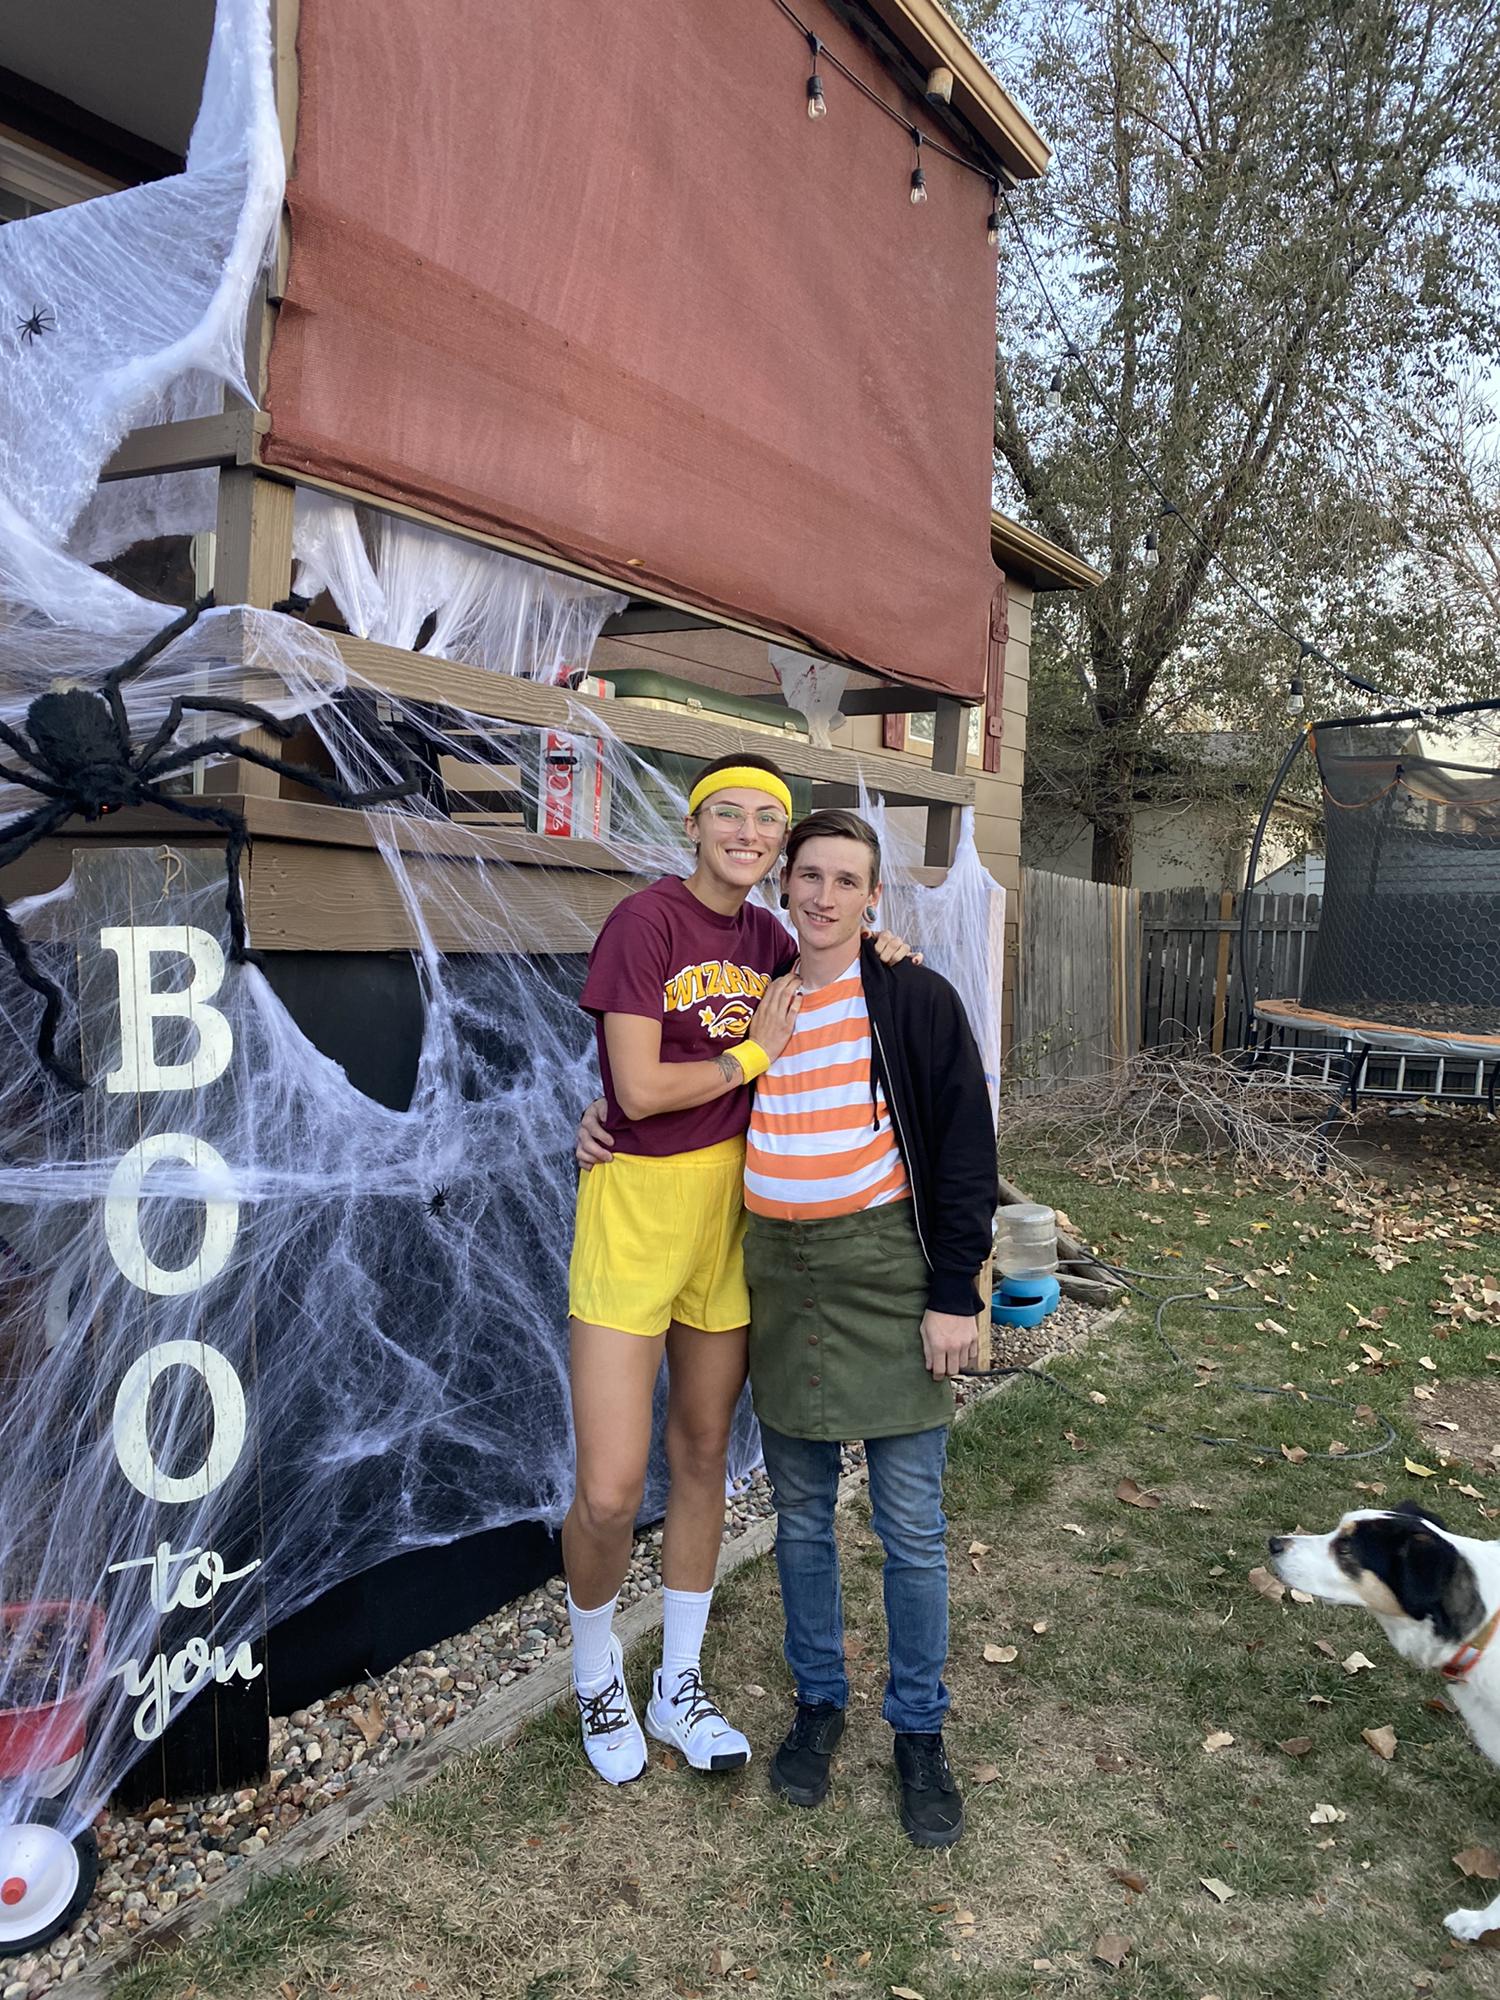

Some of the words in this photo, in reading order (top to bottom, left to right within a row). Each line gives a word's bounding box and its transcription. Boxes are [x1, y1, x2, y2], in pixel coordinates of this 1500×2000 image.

[101, 926, 246, 1502] BOO
[108, 1542, 261, 1613] to
[109, 1638, 263, 1741] you
